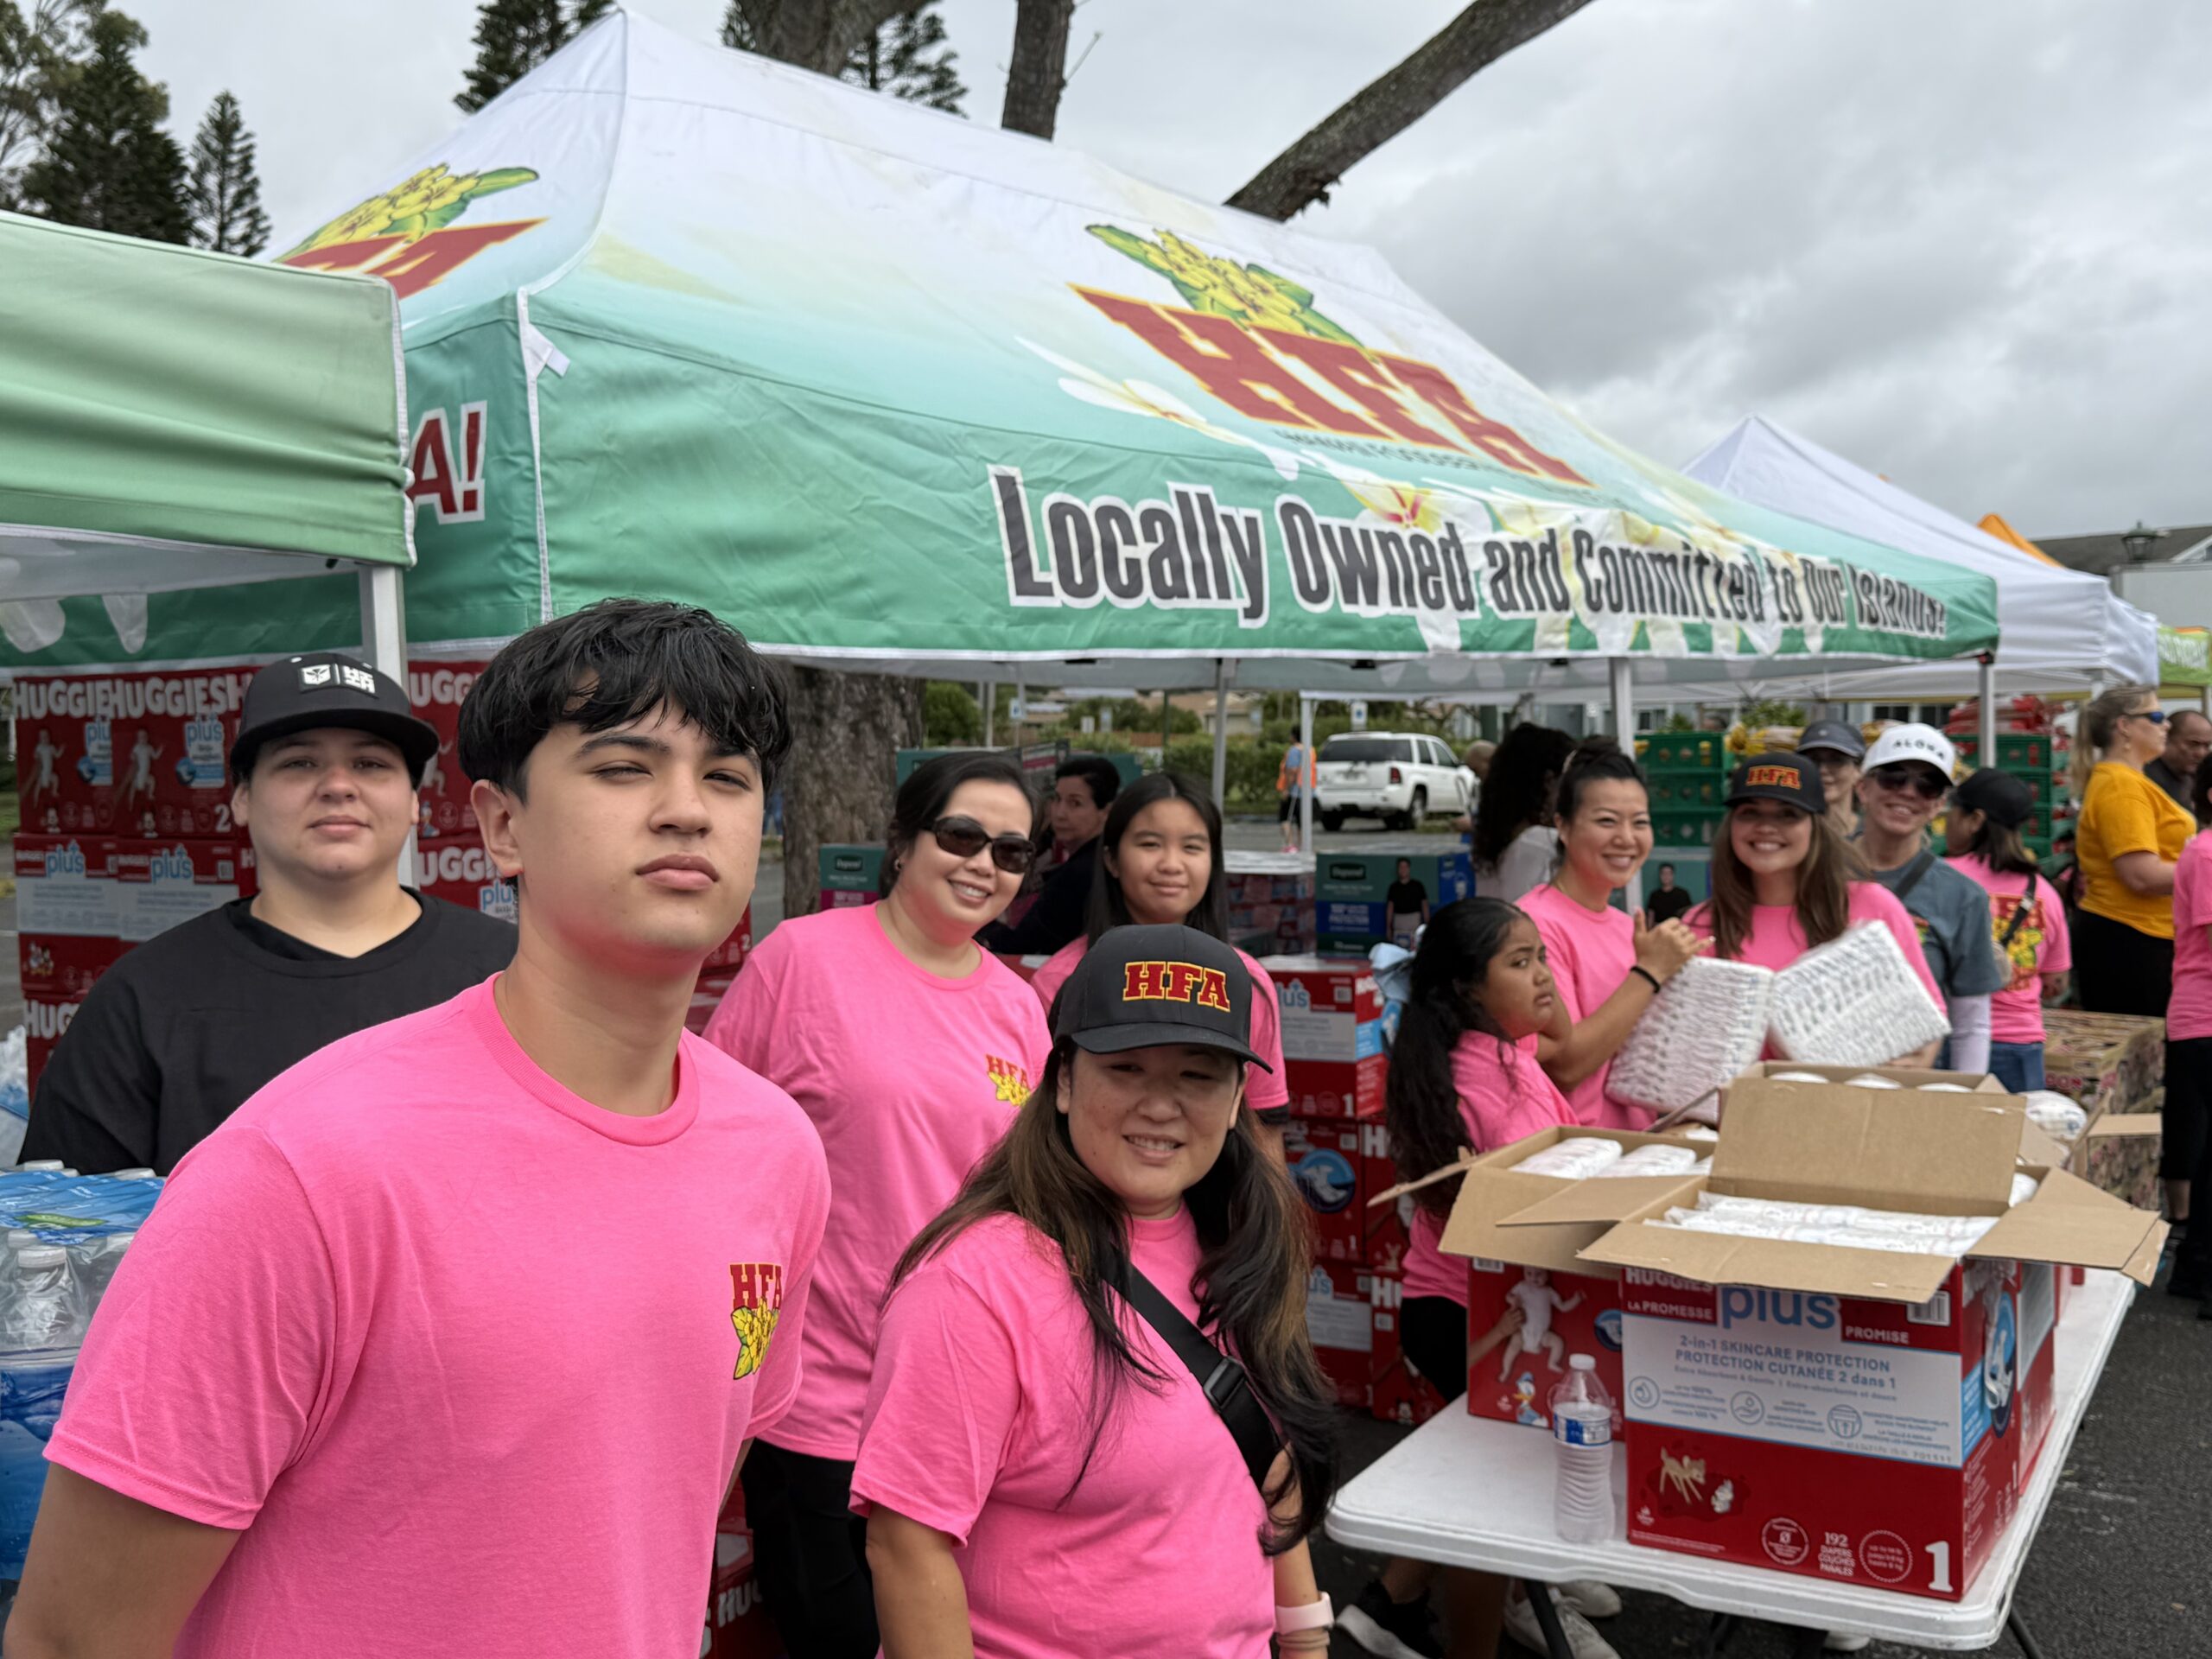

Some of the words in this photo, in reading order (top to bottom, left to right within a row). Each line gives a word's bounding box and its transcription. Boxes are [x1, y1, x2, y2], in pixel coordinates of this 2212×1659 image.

[1066, 283, 1601, 488] HFA
[405, 400, 487, 525] A!
[991, 469, 1266, 624] Locally
[1277, 498, 1478, 617] Owned
[1481, 526, 1571, 613] and
[1573, 529, 1766, 622] Committed
[1764, 557, 1803, 622] to
[1800, 557, 1847, 623] Our
[13, 679, 112, 719] HUGGIE
[111, 677, 228, 719] HUGGIES
[87, 721, 111, 746] plu
[188, 719, 223, 746] plus
[1746, 765, 1801, 790] HFA
[214, 804, 232, 833] 2
[46, 842, 85, 879] plus
[151, 848, 193, 885] plus
[480, 881, 513, 911] plu
[1122, 961, 1230, 1013] HFA
[1277, 982, 1308, 1007] lus
[23, 999, 78, 1040] HUG
[984, 1054, 1030, 1090] HFA
[729, 1263, 782, 1310] HFA
[1627, 1300, 1642, 1312] LA
[1643, 1300, 1713, 1320] PROMESSE
[1722, 1286, 1836, 1331] plus
[1680, 1334, 1718, 1351] 2-in-1
[1720, 1339, 1793, 1361] SKINCARE
[1796, 1349, 1891, 1373] PROTECTION
[1845, 1325, 1910, 1344] PROMISE
[1675, 1349, 1764, 1372] PROTECTION
[1768, 1362, 1834, 1382] CUTANÉE
[1839, 1370, 1848, 1382] 2
[1851, 1372, 1885, 1389] dans
[1890, 1377, 1897, 1389] 1
[1824, 1531, 1848, 1548] 192
[1924, 1540, 1954, 1592] 1
